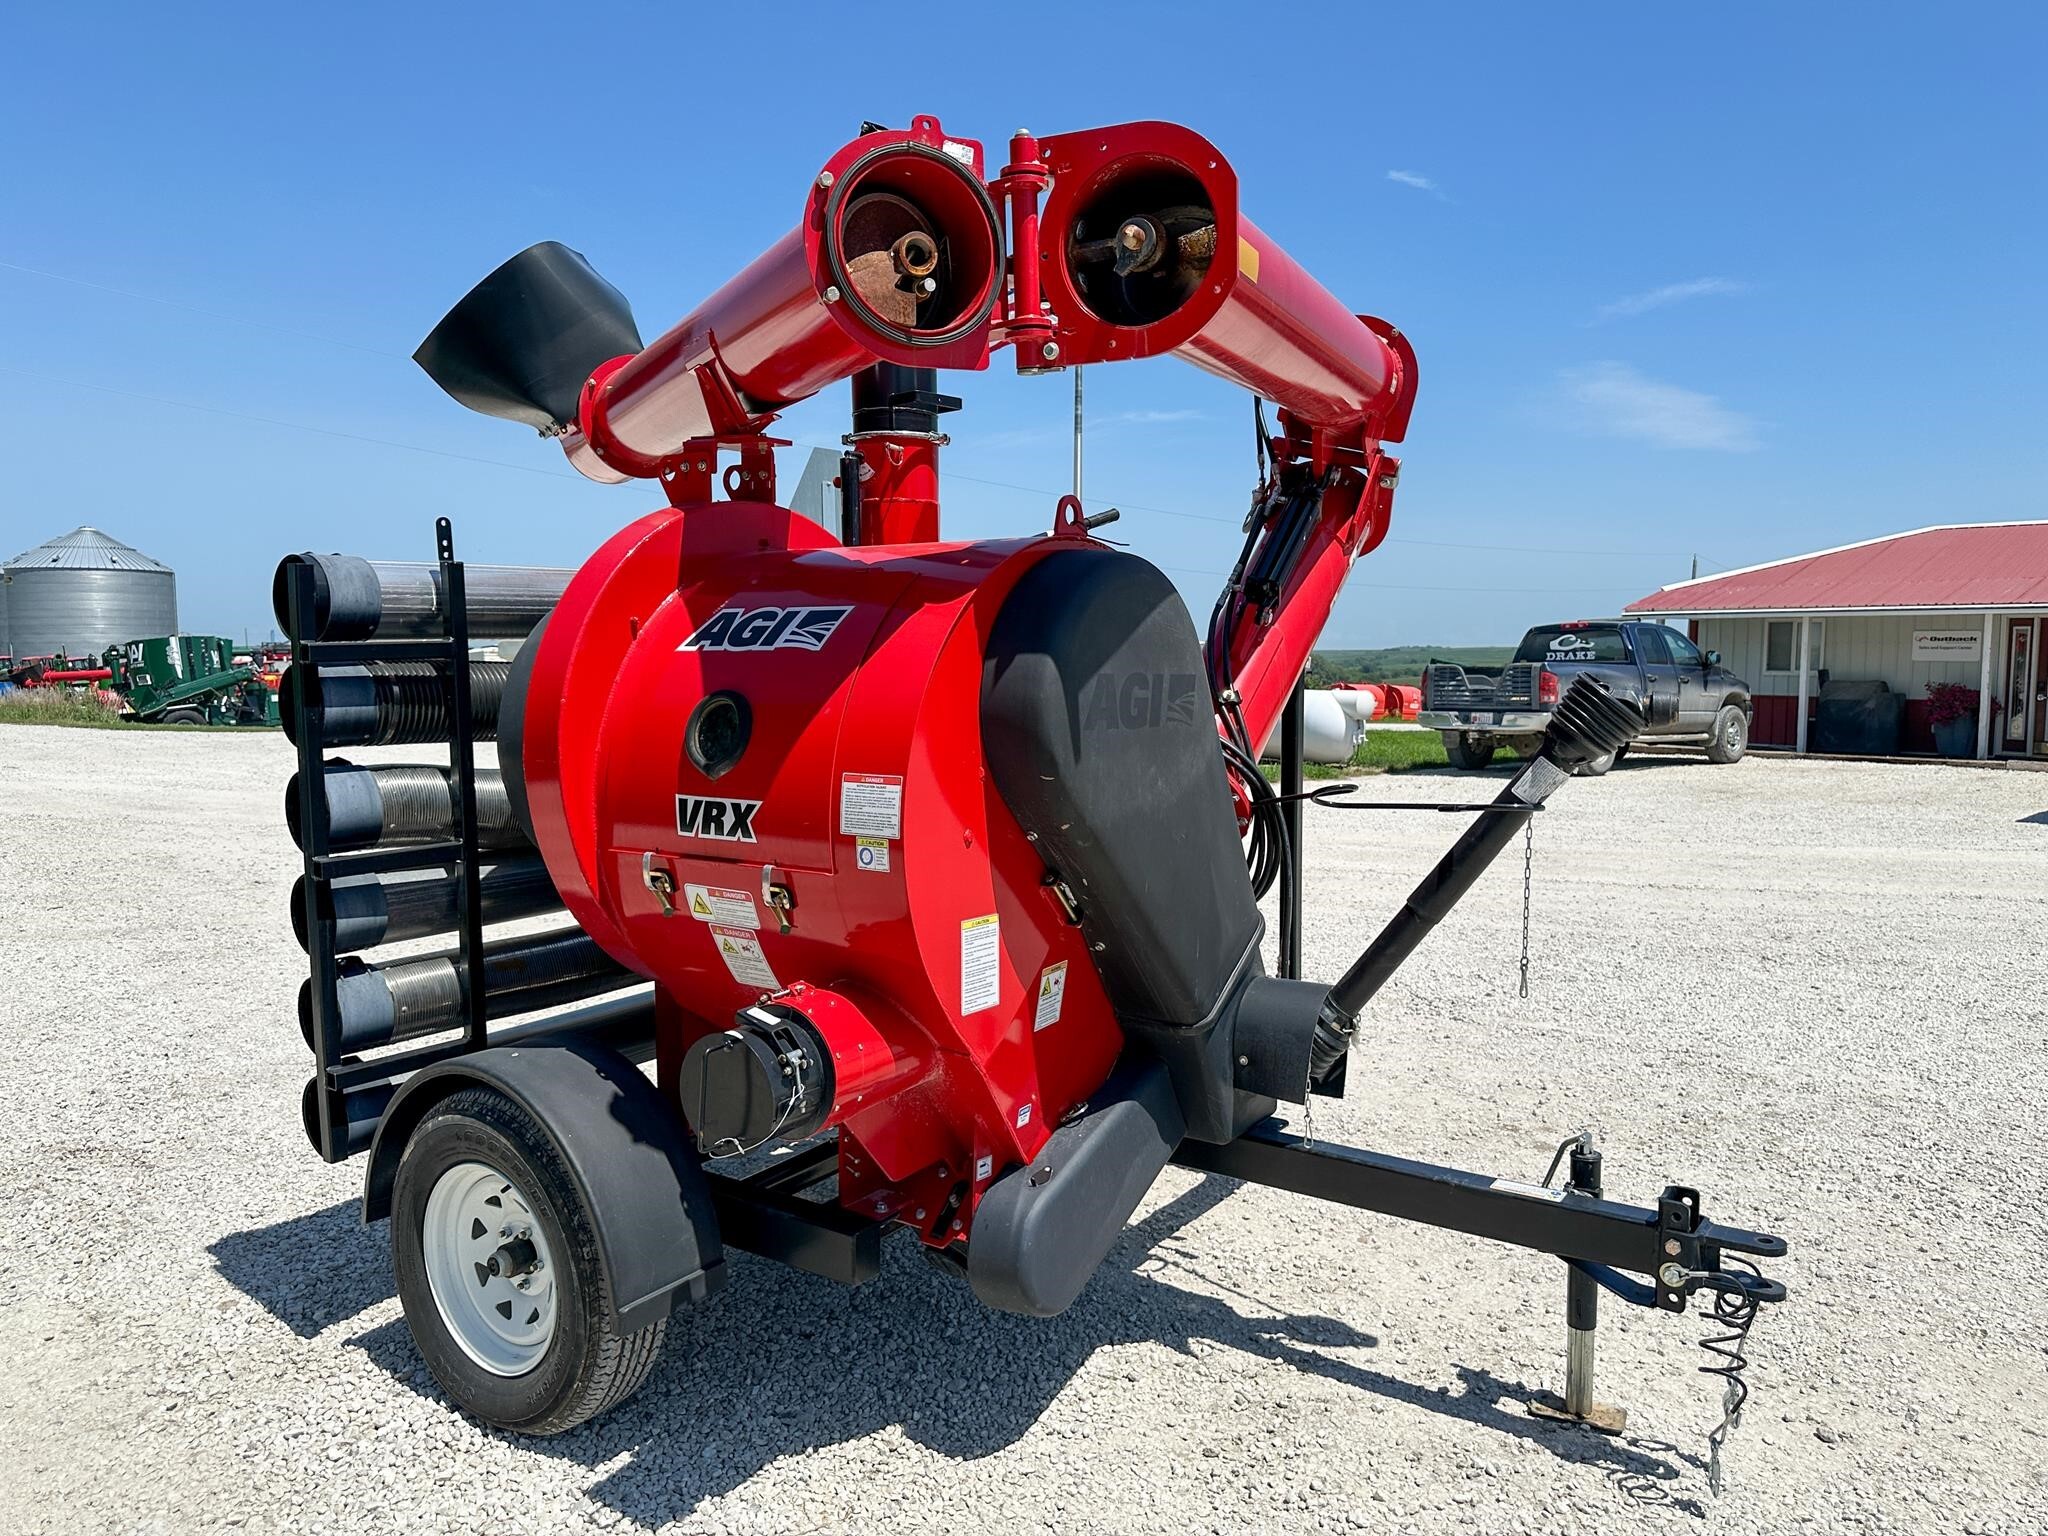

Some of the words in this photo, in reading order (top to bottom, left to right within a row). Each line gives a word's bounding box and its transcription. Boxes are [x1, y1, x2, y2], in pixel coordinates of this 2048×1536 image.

[684, 610, 802, 649] AGI
[1546, 652, 1596, 660] DRAKE
[1083, 671, 1165, 731] AGI
[678, 798, 758, 839] VRX
[723, 891, 746, 899] DANGER
[724, 929, 752, 939] DANGER
